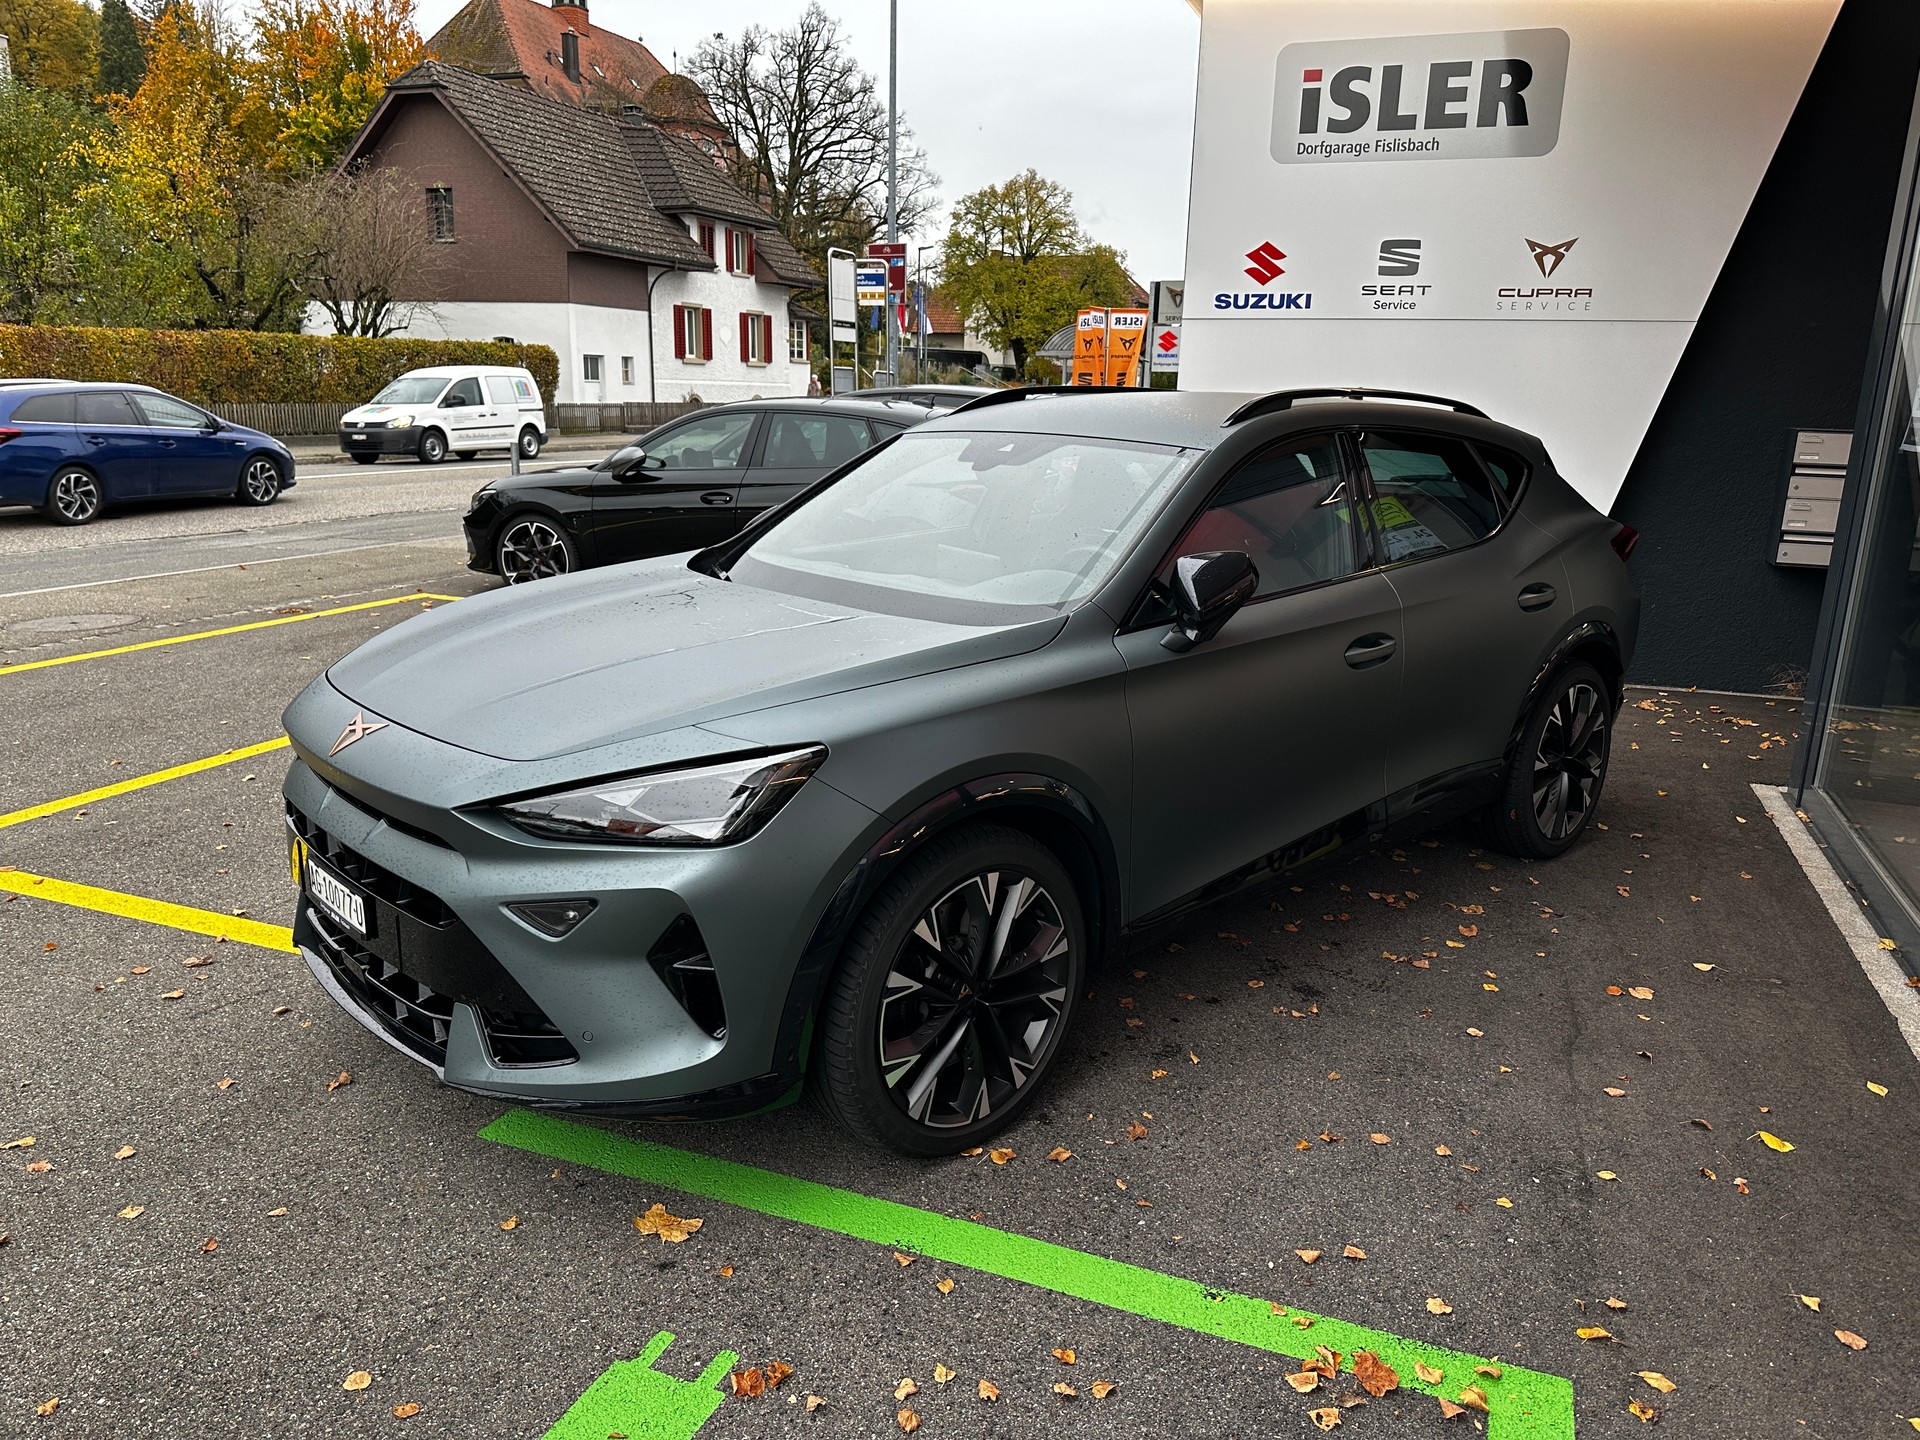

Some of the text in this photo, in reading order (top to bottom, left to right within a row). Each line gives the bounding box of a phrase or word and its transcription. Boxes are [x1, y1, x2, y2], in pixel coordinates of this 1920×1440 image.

[1299, 58, 1533, 134] iSLER
[1296, 136, 1440, 158] Dorfgarage Fislisbach
[1361, 285, 1432, 296] SEAT
[1498, 288, 1592, 298] CUPRA
[1214, 293, 1312, 310] SUZUKI
[1373, 300, 1417, 310] Service
[1496, 301, 1591, 311] SERVICE
